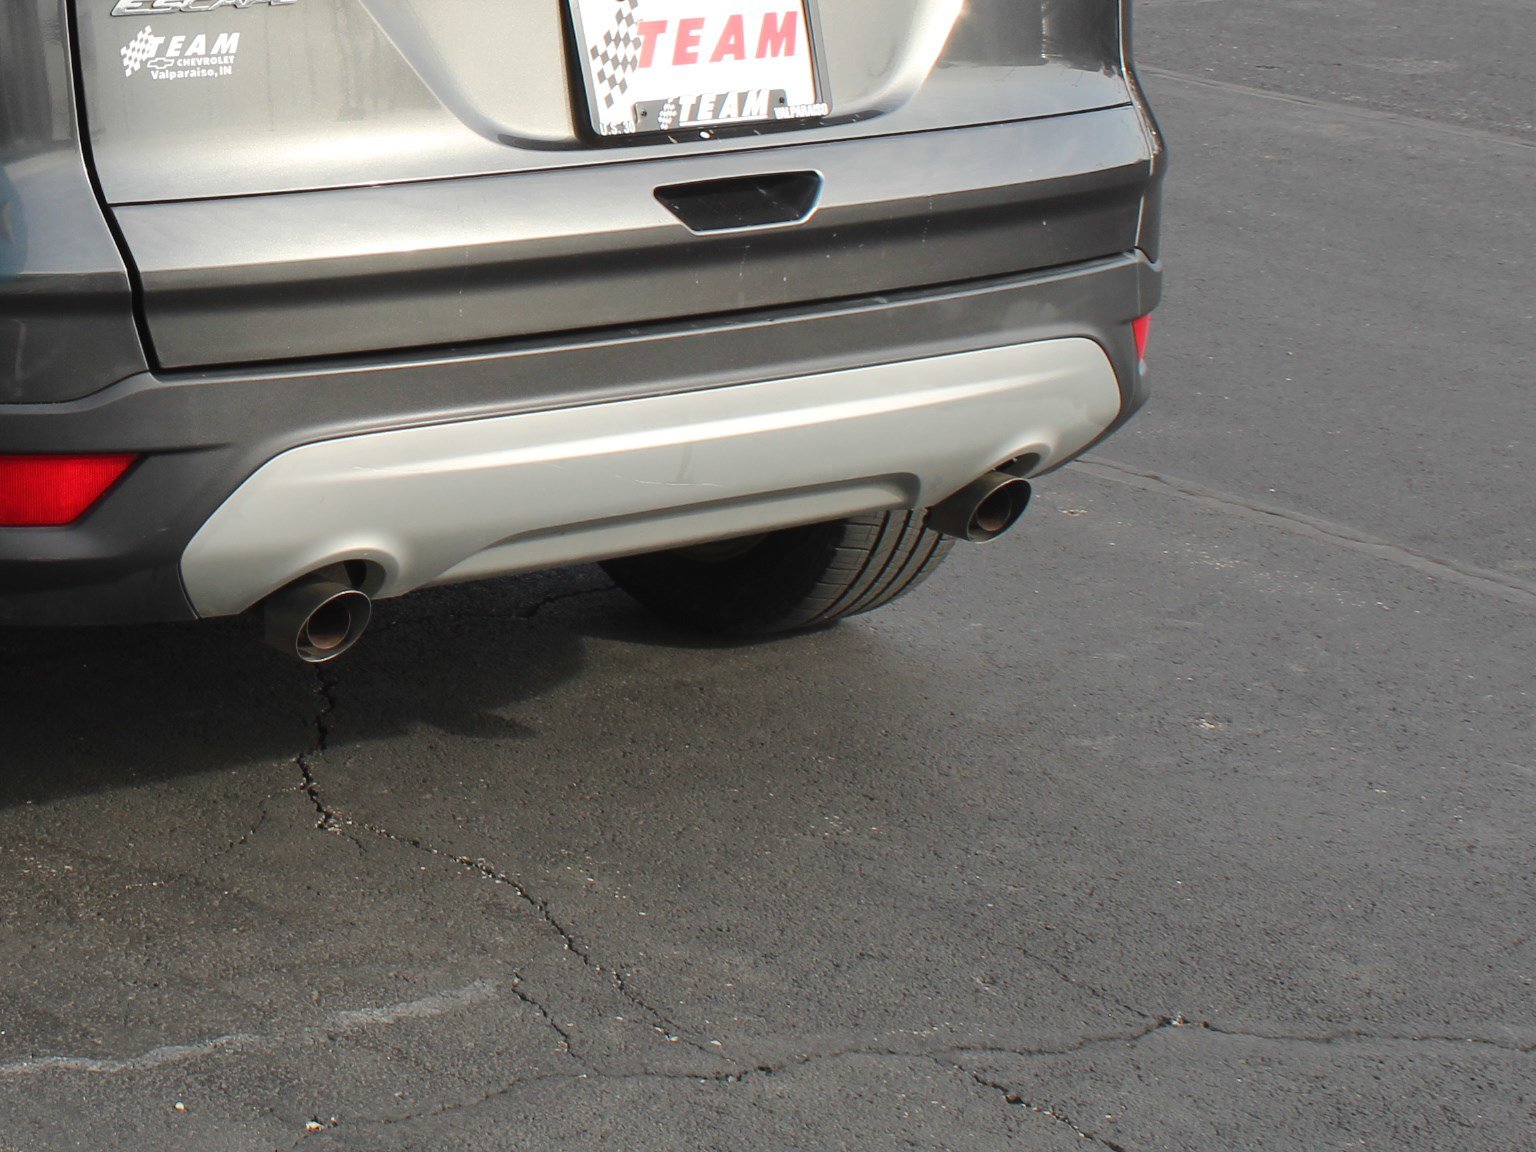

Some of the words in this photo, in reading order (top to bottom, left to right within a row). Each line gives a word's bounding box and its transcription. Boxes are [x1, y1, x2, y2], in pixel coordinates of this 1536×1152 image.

[145, 32, 241, 58] TEAM
[637, 10, 798, 69] TEAM
[176, 55, 235, 67] CHEVROLET
[678, 90, 770, 122] TEAM
